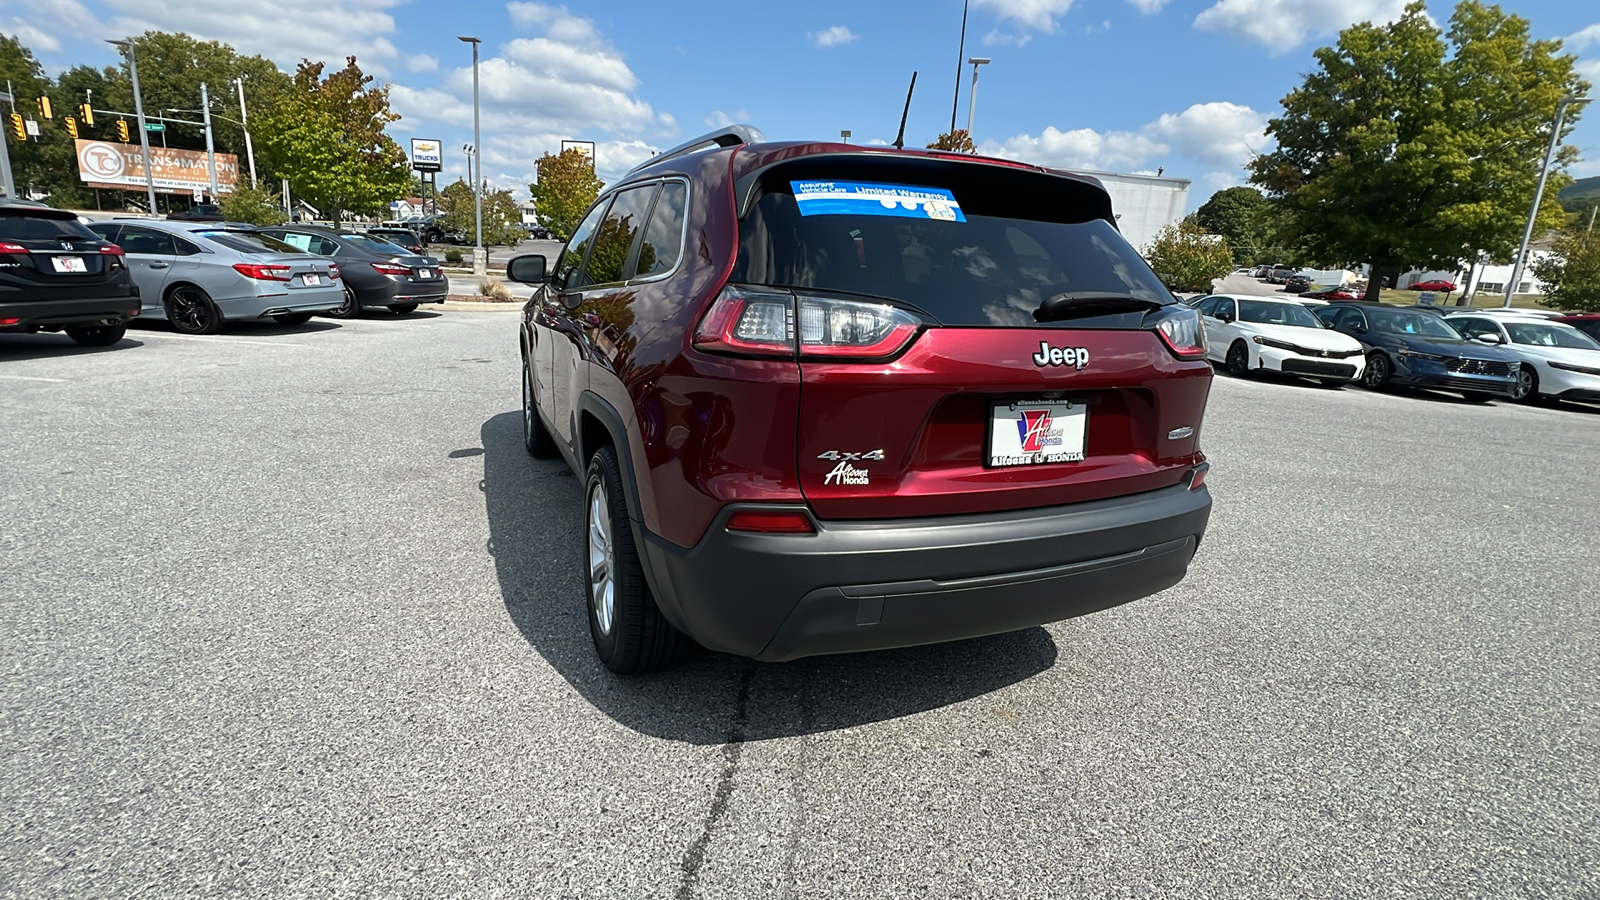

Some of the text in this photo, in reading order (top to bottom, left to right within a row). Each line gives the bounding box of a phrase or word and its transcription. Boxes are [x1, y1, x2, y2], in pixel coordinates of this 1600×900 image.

[124, 153, 235, 173] TRNS4MATON
[855, 186, 948, 201] Limited Warranty
[1032, 341, 1090, 371] Jeep
[1038, 437, 1062, 445] Honda
[990, 452, 1085, 467] Altoona HONDA
[843, 477, 869, 485] Honda
